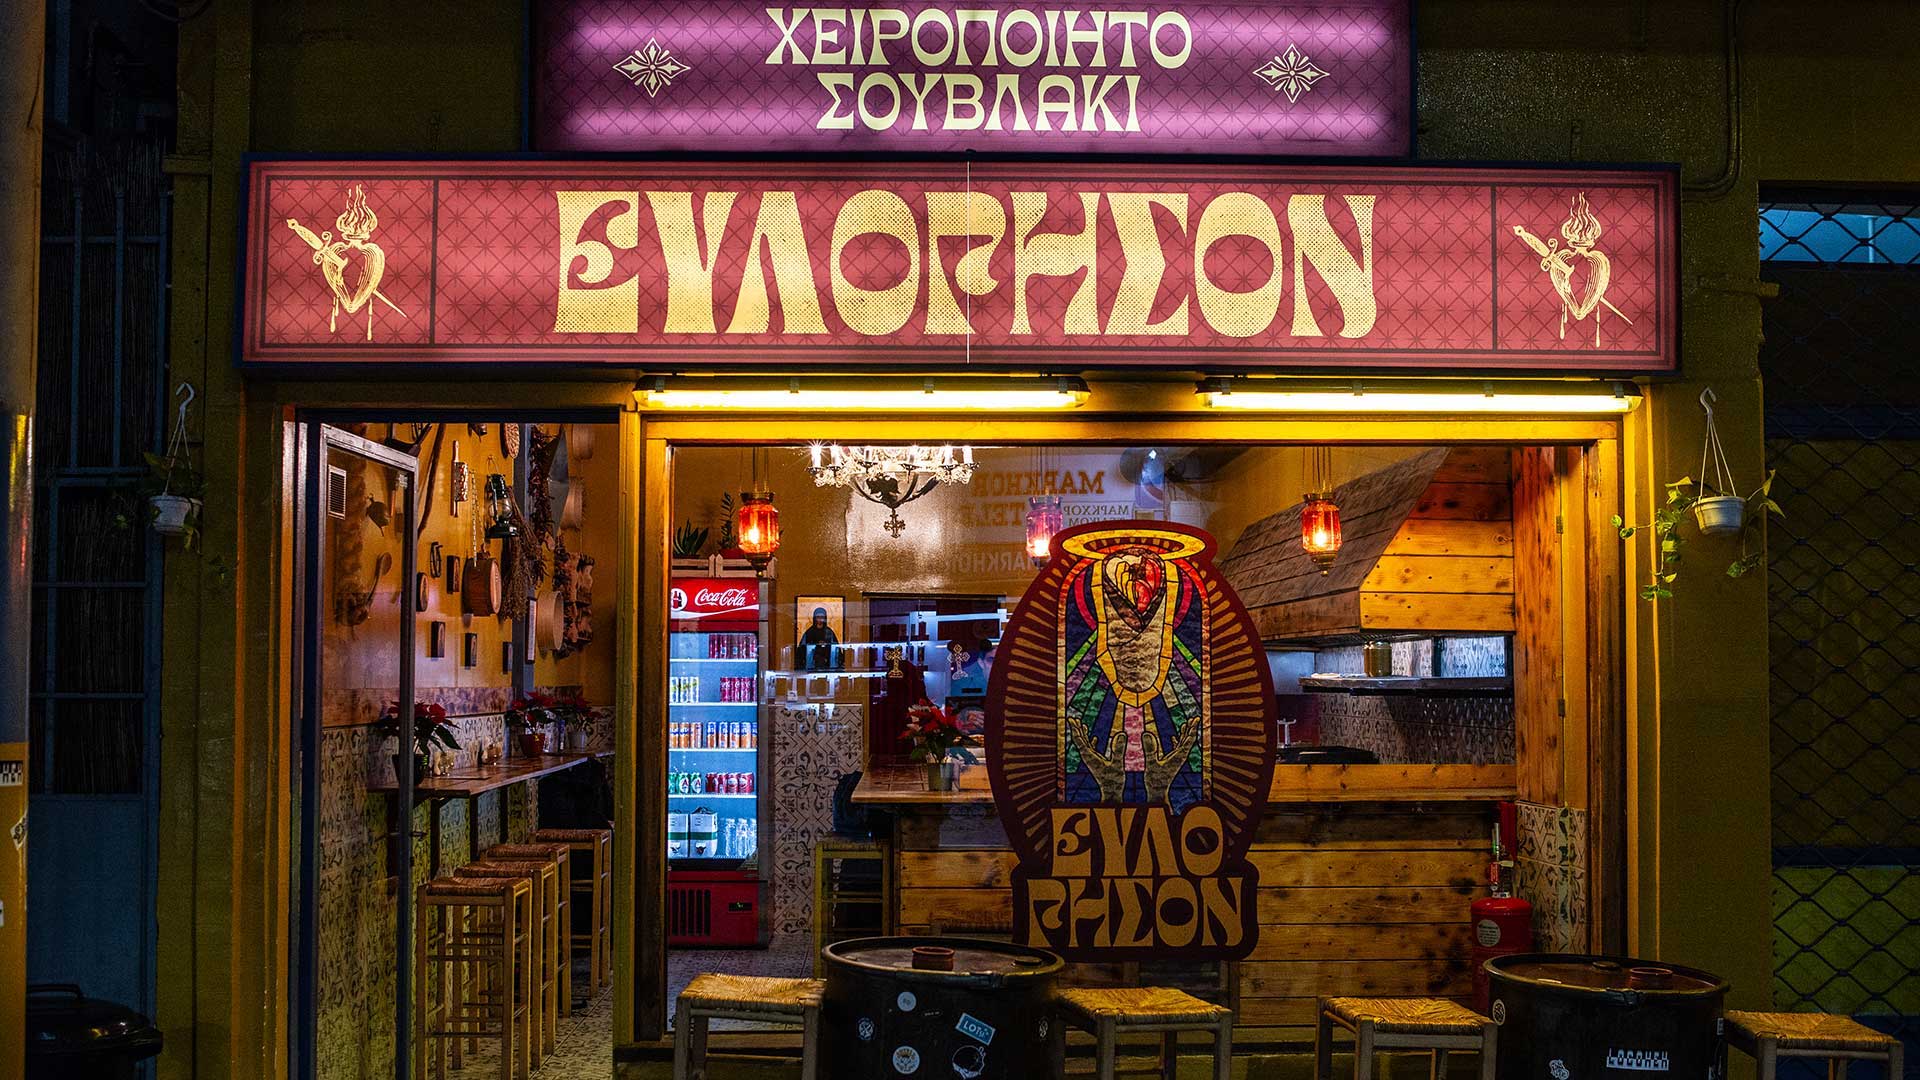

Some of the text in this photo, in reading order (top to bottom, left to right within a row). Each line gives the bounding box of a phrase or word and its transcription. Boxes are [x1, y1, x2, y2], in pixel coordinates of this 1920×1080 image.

[766, 8, 1192, 68] ΧΕΙΡΟΠΟΙΗΤΟ
[818, 73, 1140, 132] ΣΟΥΒΛΑΚΙ
[554, 190, 1378, 338] ΕΥΛΟΓΗΣΟΝ
[694, 588, 749, 607] Coca-Cola
[1051, 806, 1224, 877] ΕΥΛΟ
[1027, 876, 1243, 948] ΓΗΣΟΝ
